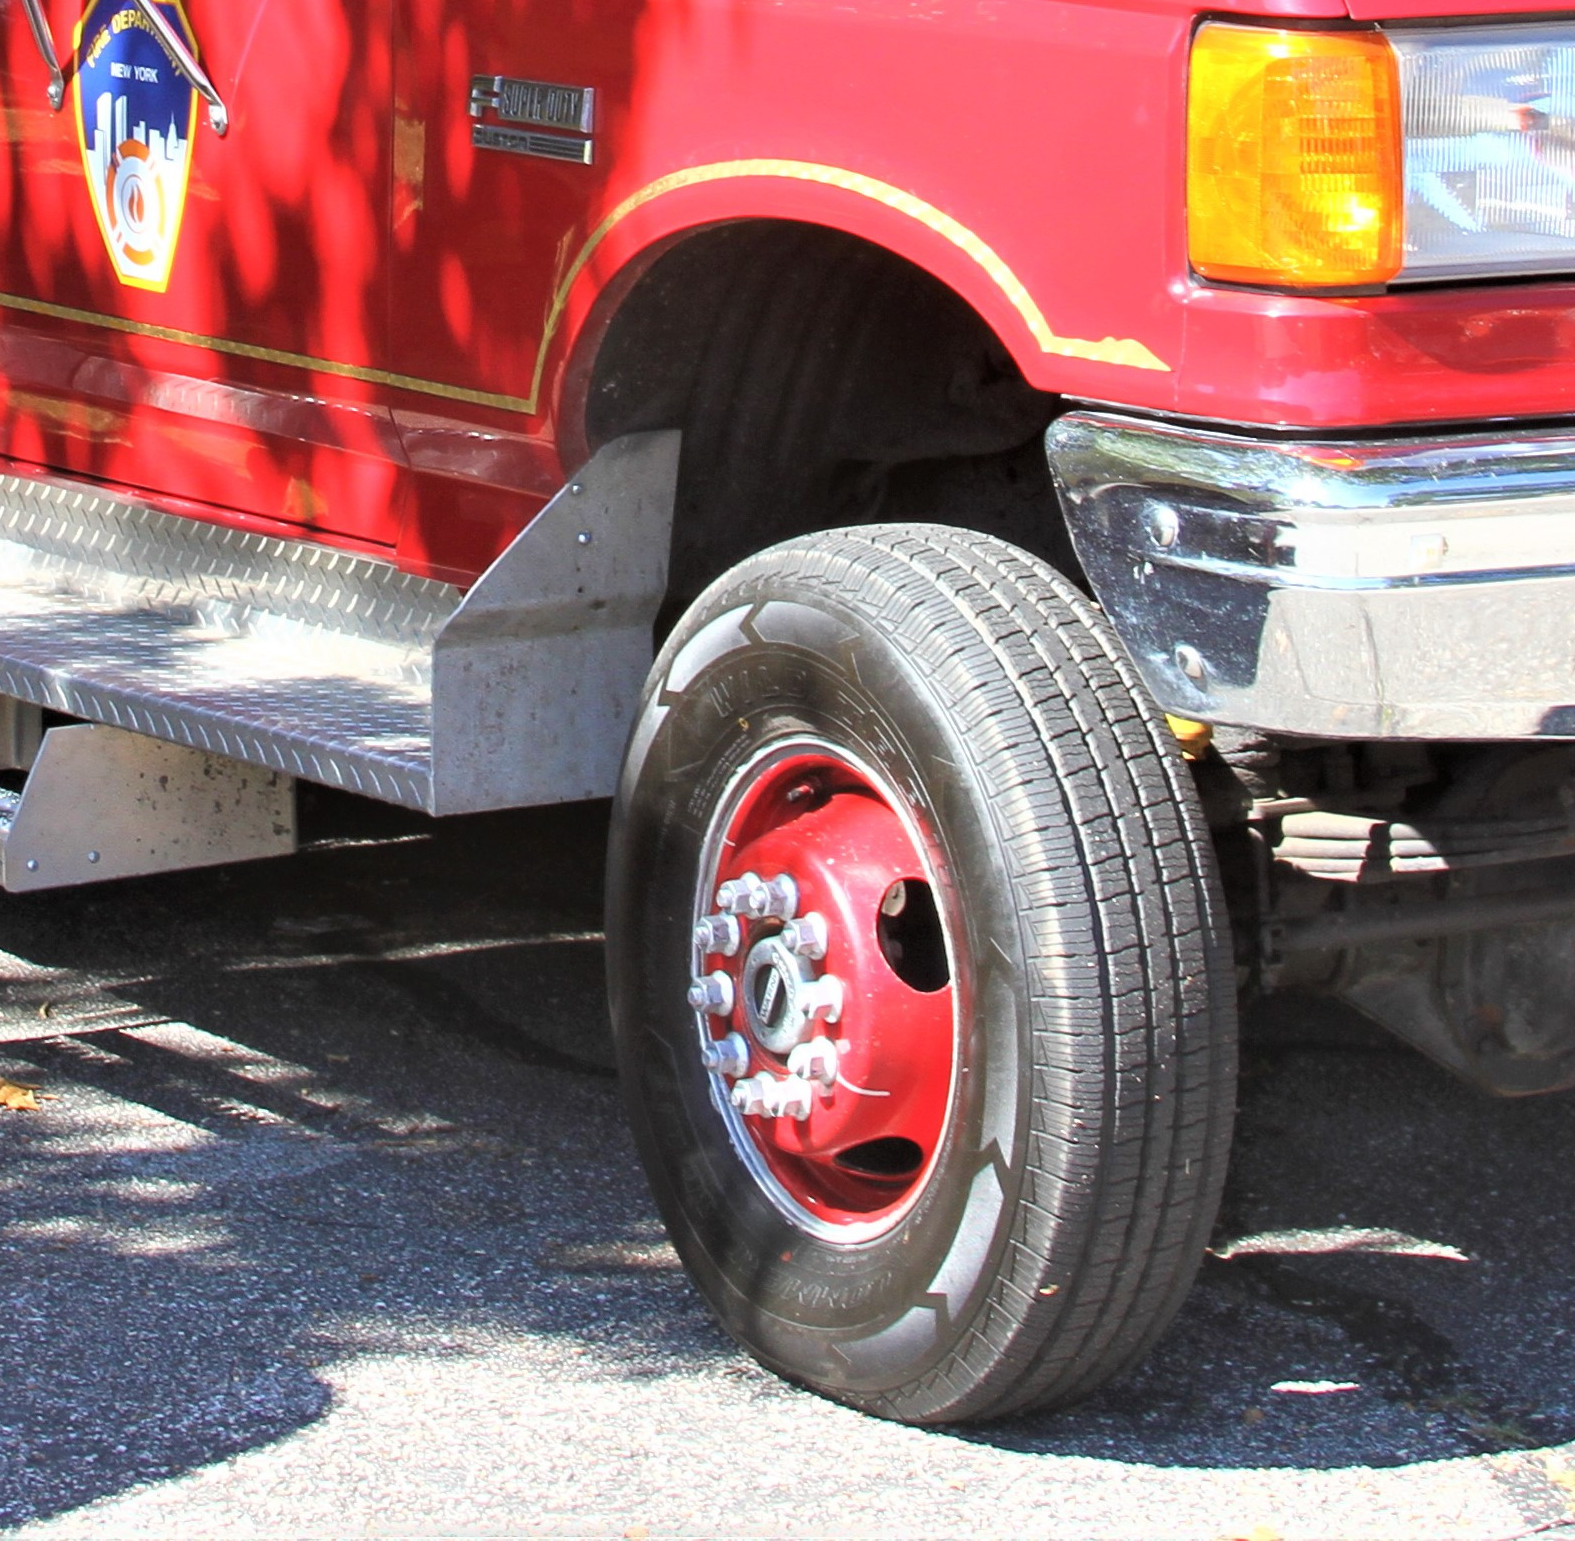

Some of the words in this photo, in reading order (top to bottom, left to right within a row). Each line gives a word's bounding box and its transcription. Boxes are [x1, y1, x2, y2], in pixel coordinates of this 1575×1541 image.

[87, 25, 112, 69] FIRE
[111, 61, 132, 79] NEW
[133, 65, 159, 84] YORK
